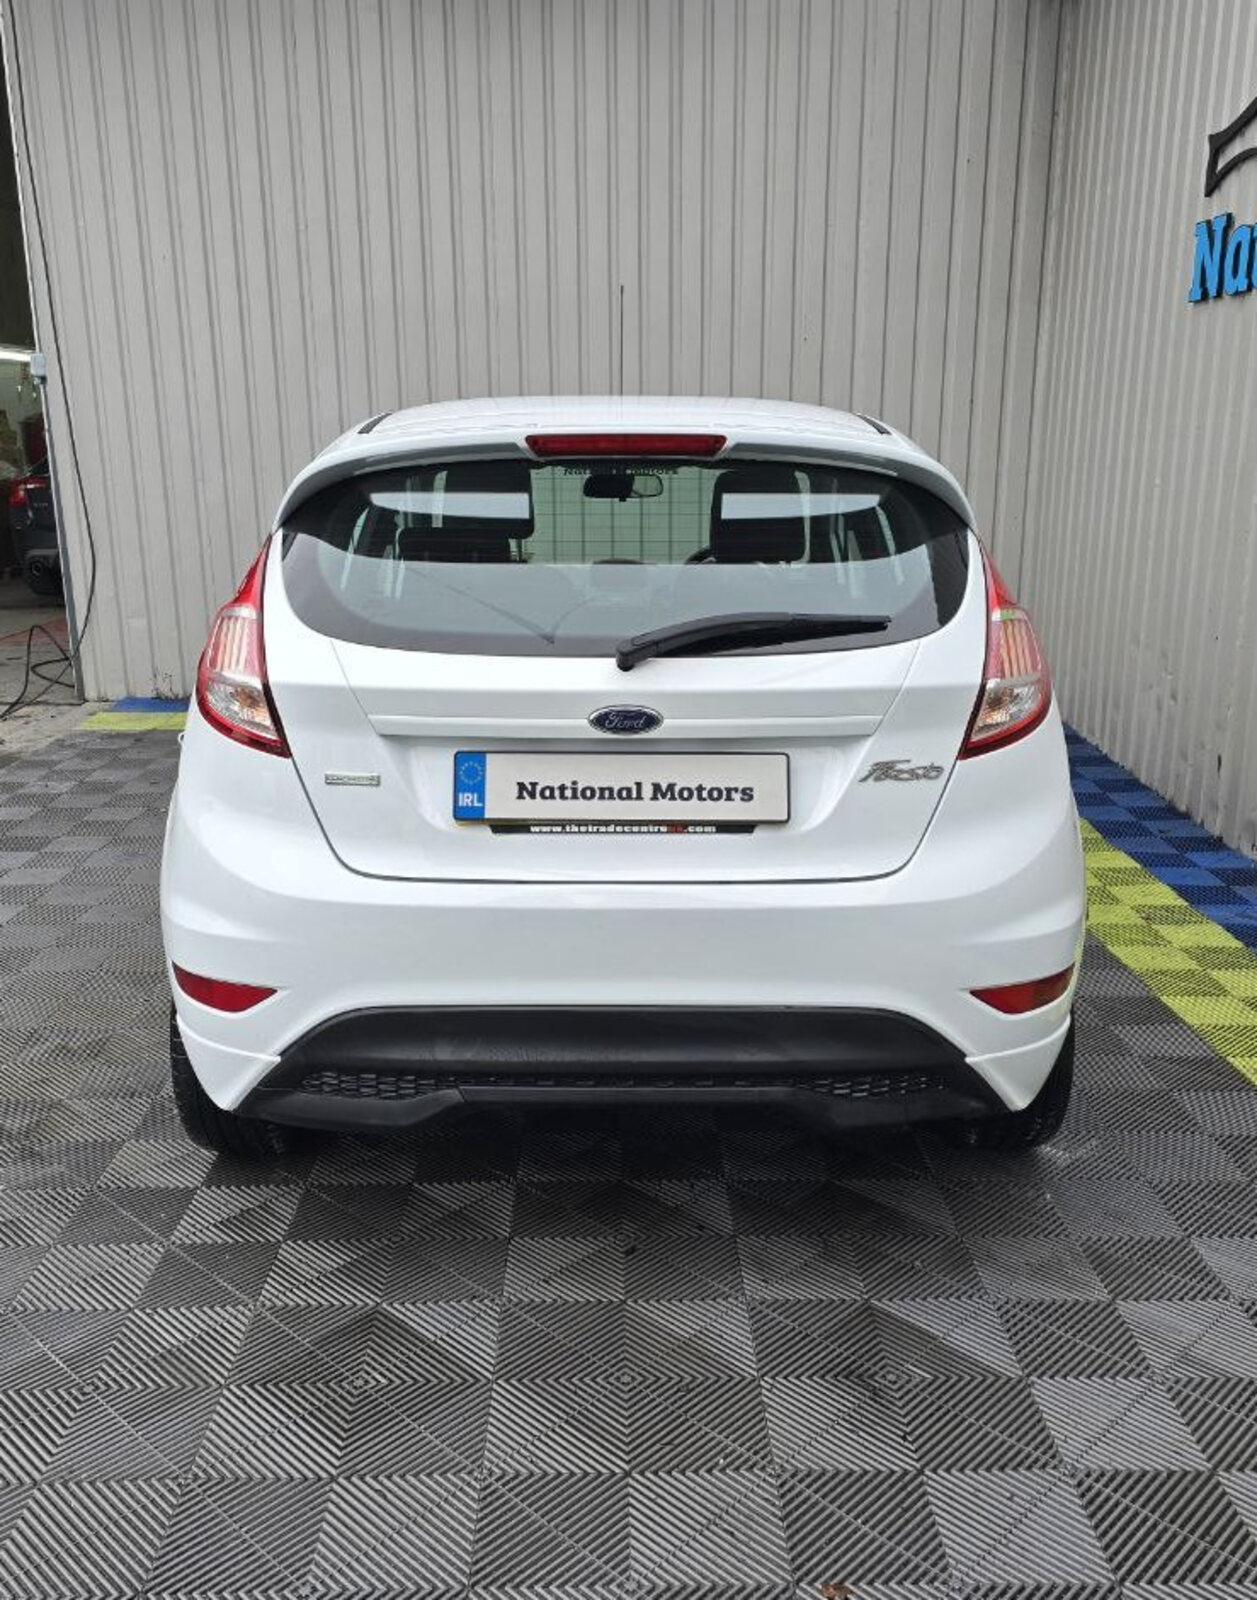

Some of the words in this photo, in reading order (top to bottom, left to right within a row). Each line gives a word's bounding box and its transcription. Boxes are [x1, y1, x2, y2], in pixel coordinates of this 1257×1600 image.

[1188, 212, 1257, 304] Na
[604, 711, 648, 729] Ford
[458, 793, 484, 807] IRL
[515, 780, 644, 801] National
[650, 781, 755, 803] Motors
